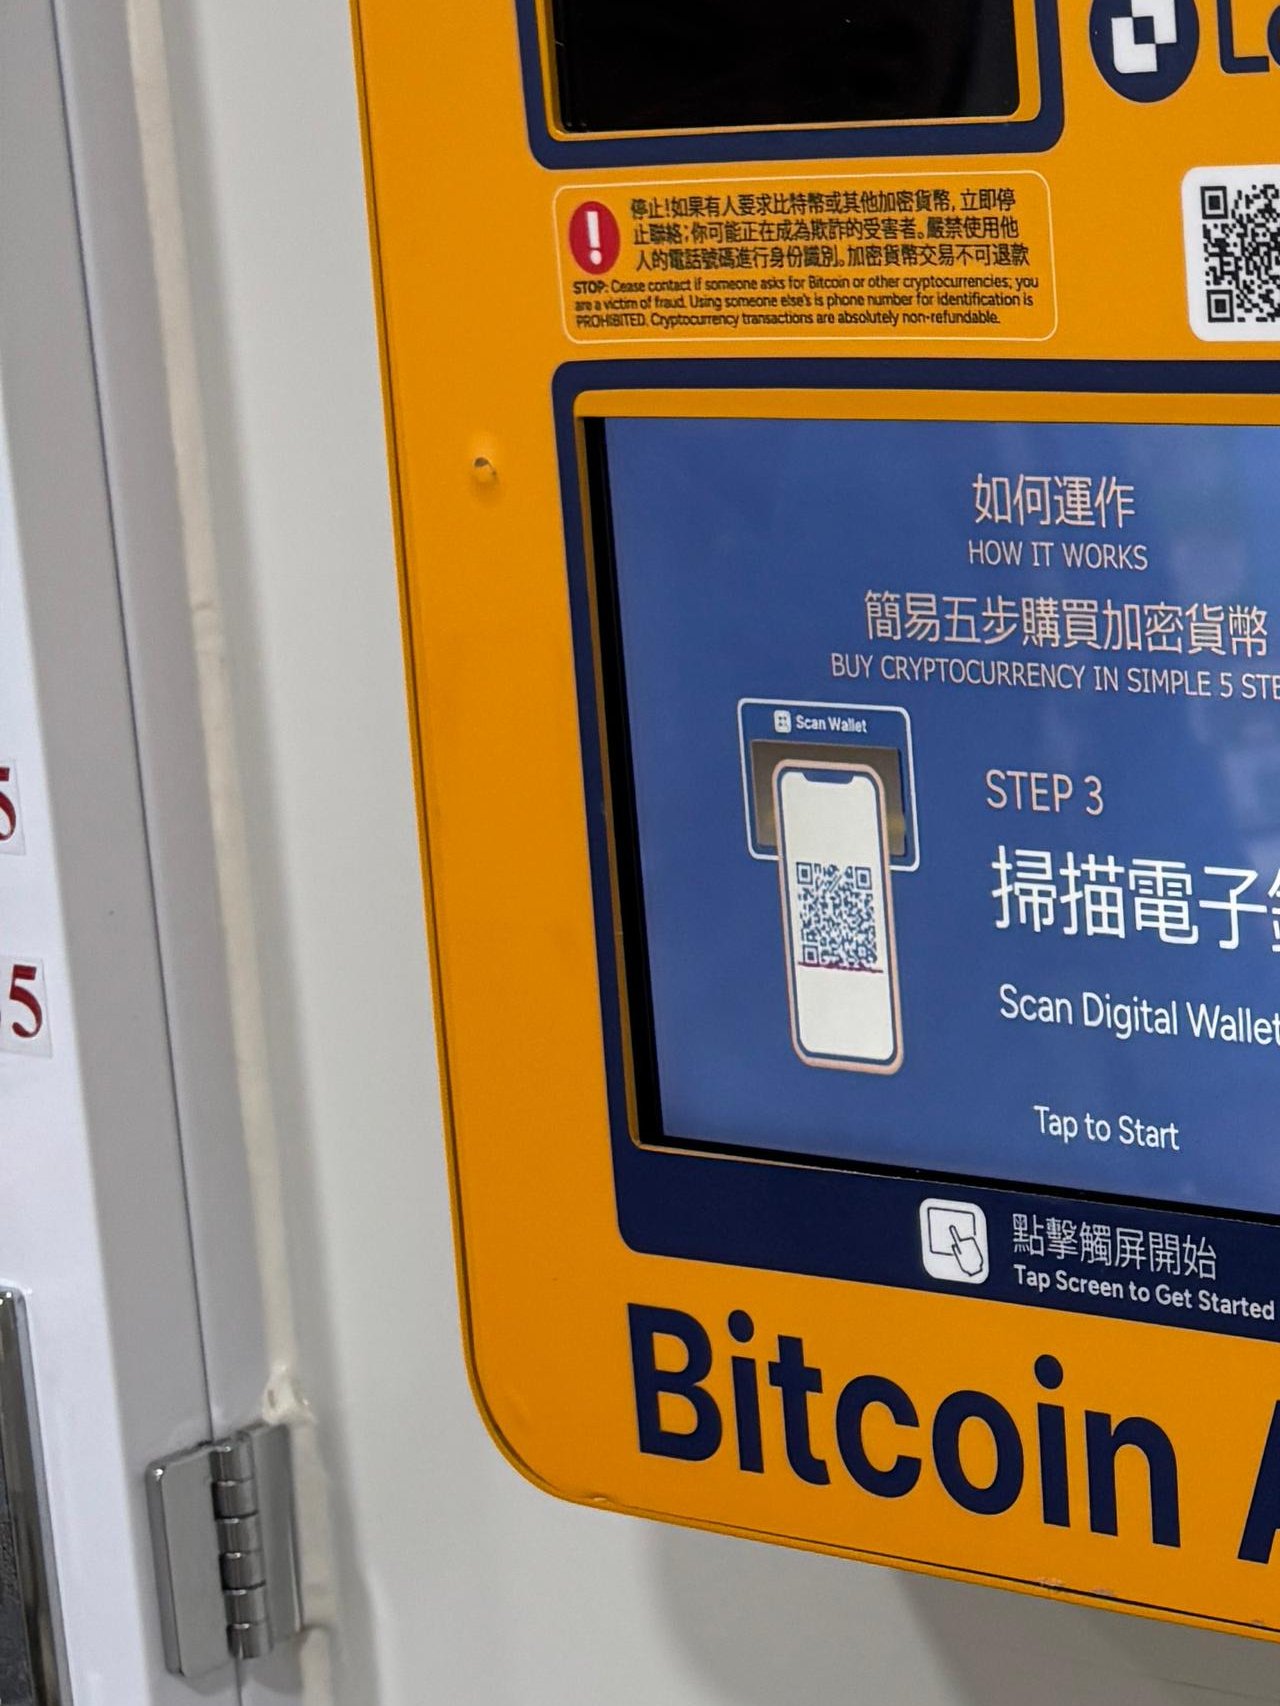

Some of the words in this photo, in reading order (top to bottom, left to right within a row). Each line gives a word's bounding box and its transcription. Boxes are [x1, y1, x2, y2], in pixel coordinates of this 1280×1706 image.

[972, 472, 1136, 529] 如何運作
[968, 540, 1023, 567] HOW
[1032, 542, 1054, 568] IT
[1061, 542, 1148, 571] WORKS
[864, 589, 1268, 658] 簡易五步購買加密貨幣
[831, 653, 874, 679] BUY
[880, 655, 1086, 690] CRYPTOCURRENCY
[1094, 665, 1121, 691] IN
[1126, 667, 1212, 698] SIMPLE
[1220, 672, 1233, 698] 5
[796, 715, 826, 731] Scan
[828, 717, 866, 733] Wallet
[985, 769, 1073, 813] STEP
[1084, 775, 1104, 816] 3
[999, 984, 1073, 1025] Scan
[1082, 992, 1178, 1040] Digital
[1033, 1105, 1079, 1144] Tap
[1084, 1112, 1111, 1143] to
[1118, 1114, 1180, 1151] Start
[1012, 1213, 1217, 1281] 點擊觸屏開始
[1013, 1264, 1051, 1293] Tap
[1056, 1269, 1124, 1299] Screen
[1129, 1281, 1151, 1303] to
[1155, 1284, 1193, 1309] Get
[1198, 1292, 1275, 1321] Started
[626, 1301, 1181, 1550] Bitcoin
